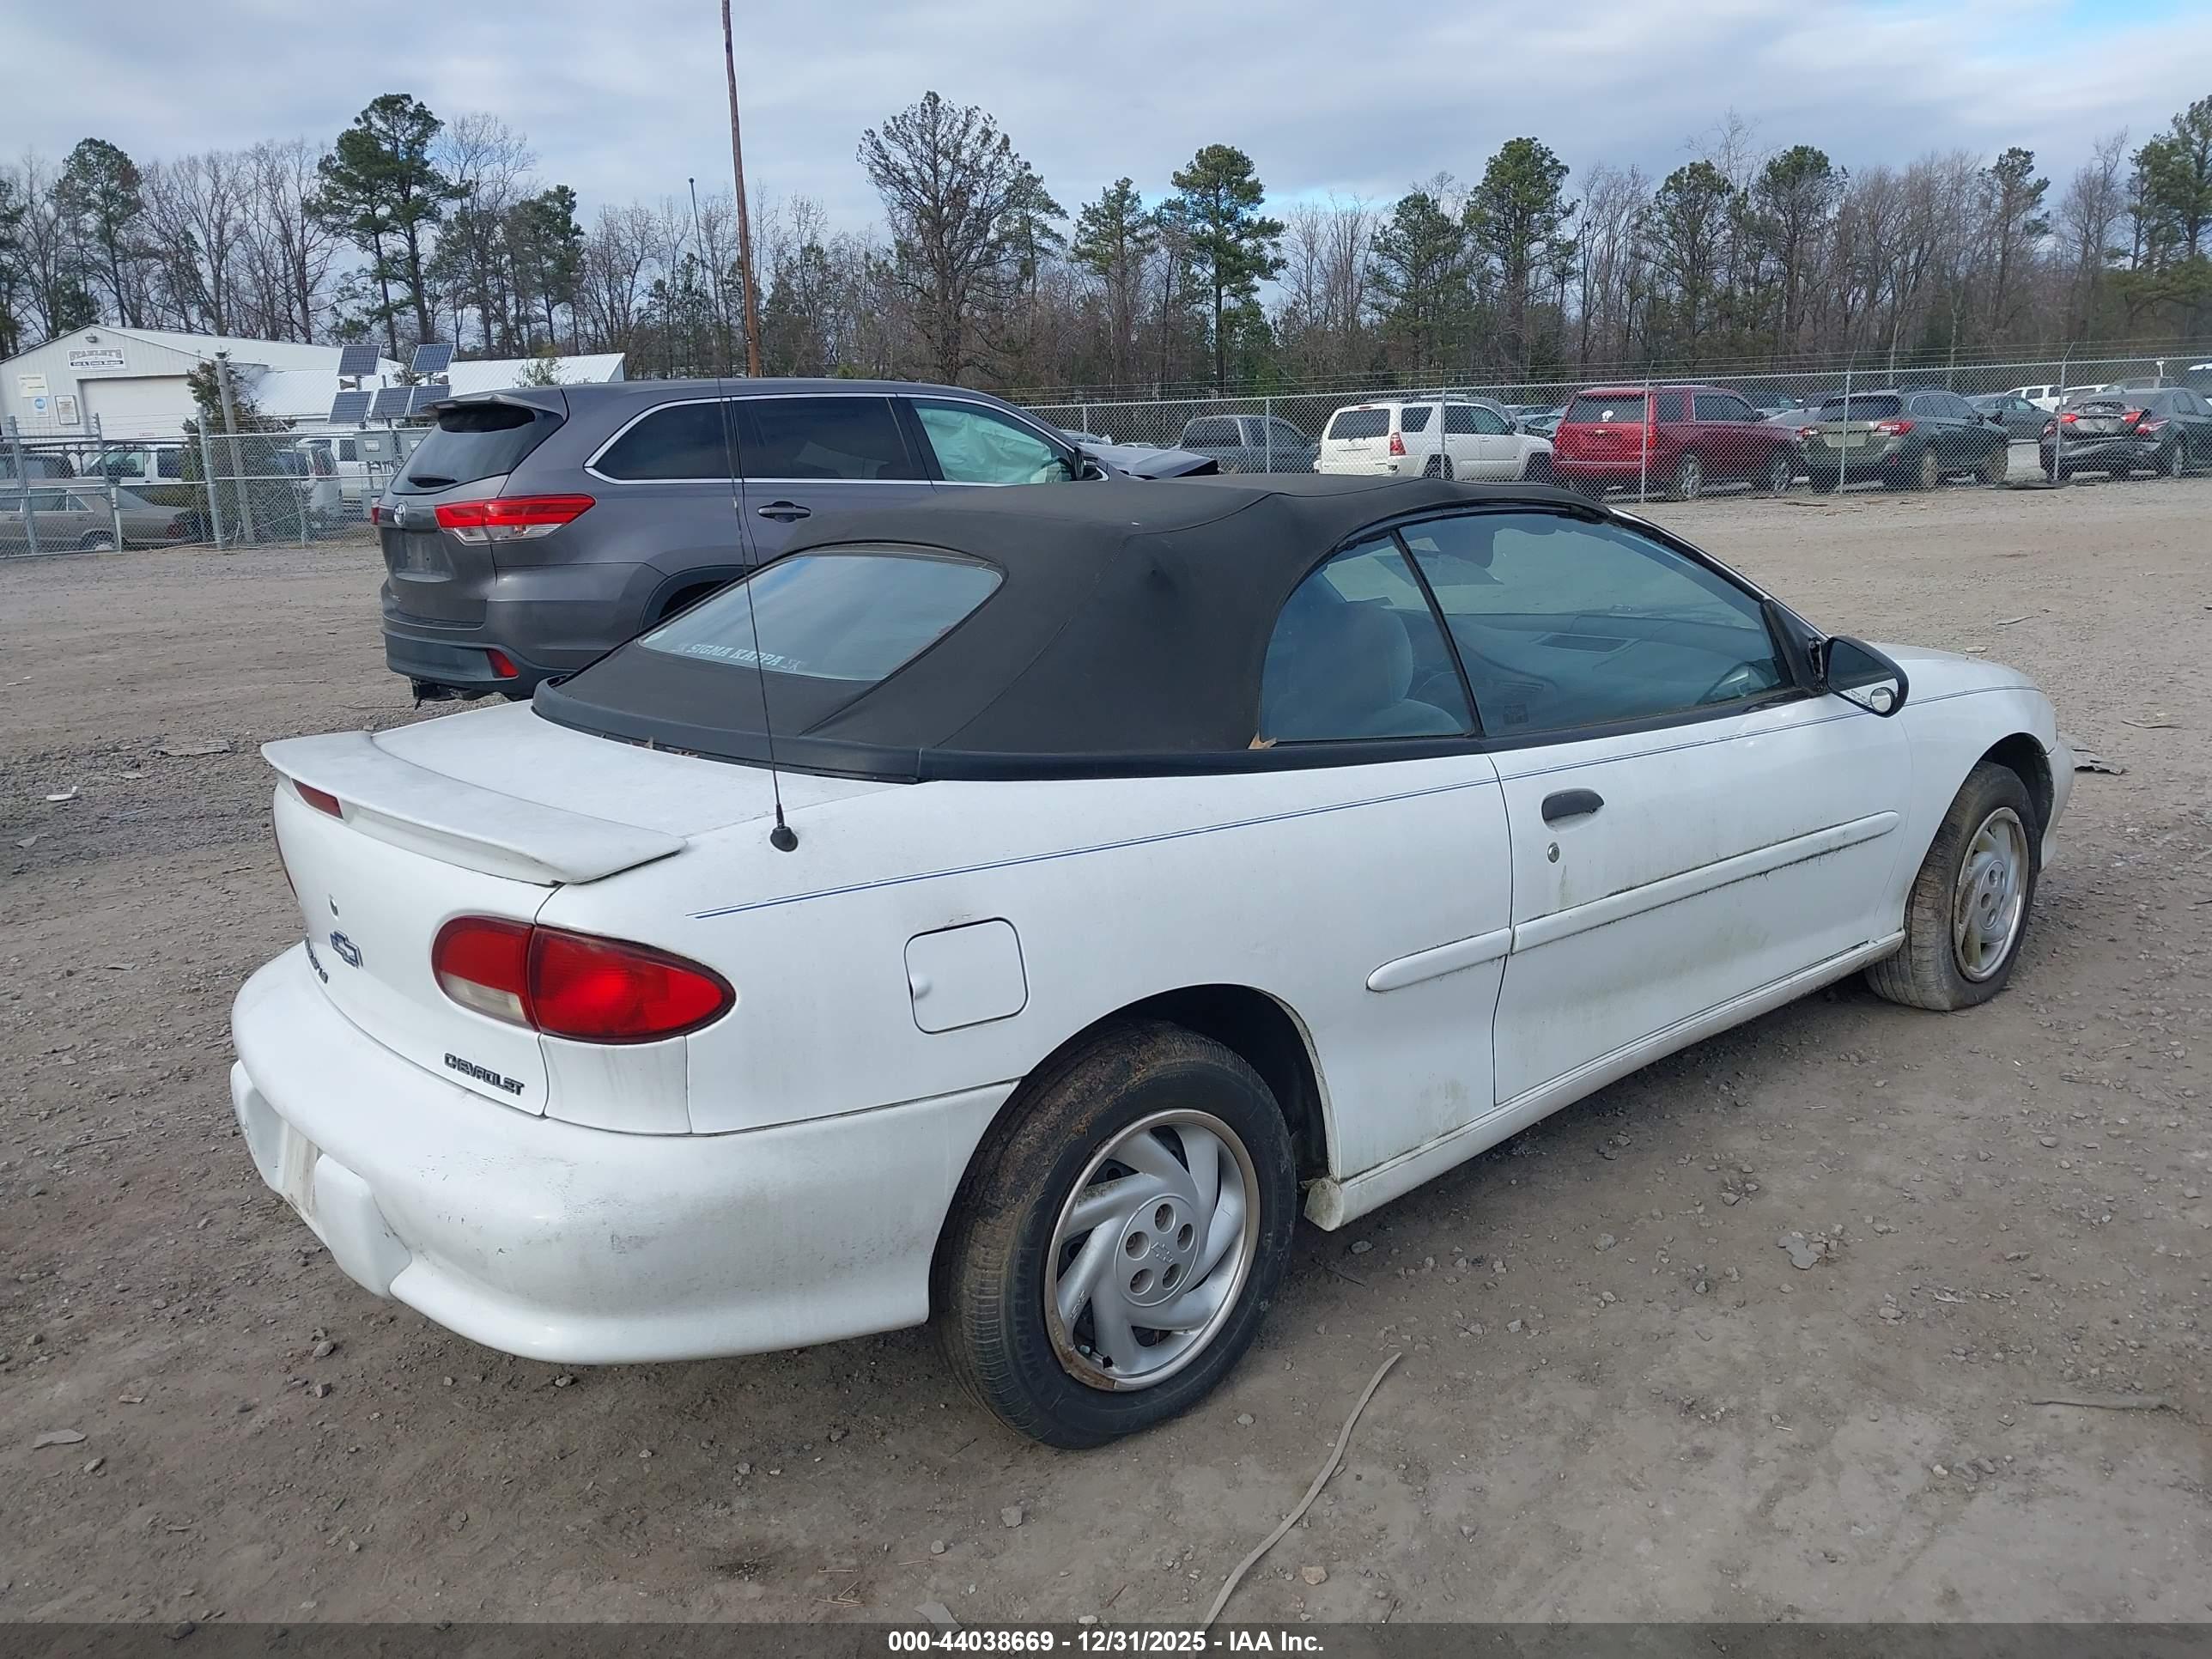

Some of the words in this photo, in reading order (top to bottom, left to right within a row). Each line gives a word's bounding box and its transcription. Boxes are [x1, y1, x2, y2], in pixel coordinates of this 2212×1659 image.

[687, 644, 733, 657] SIGMA
[729, 648, 785, 666] KAPPA
[445, 1053, 525, 1096] CHEVROLET
